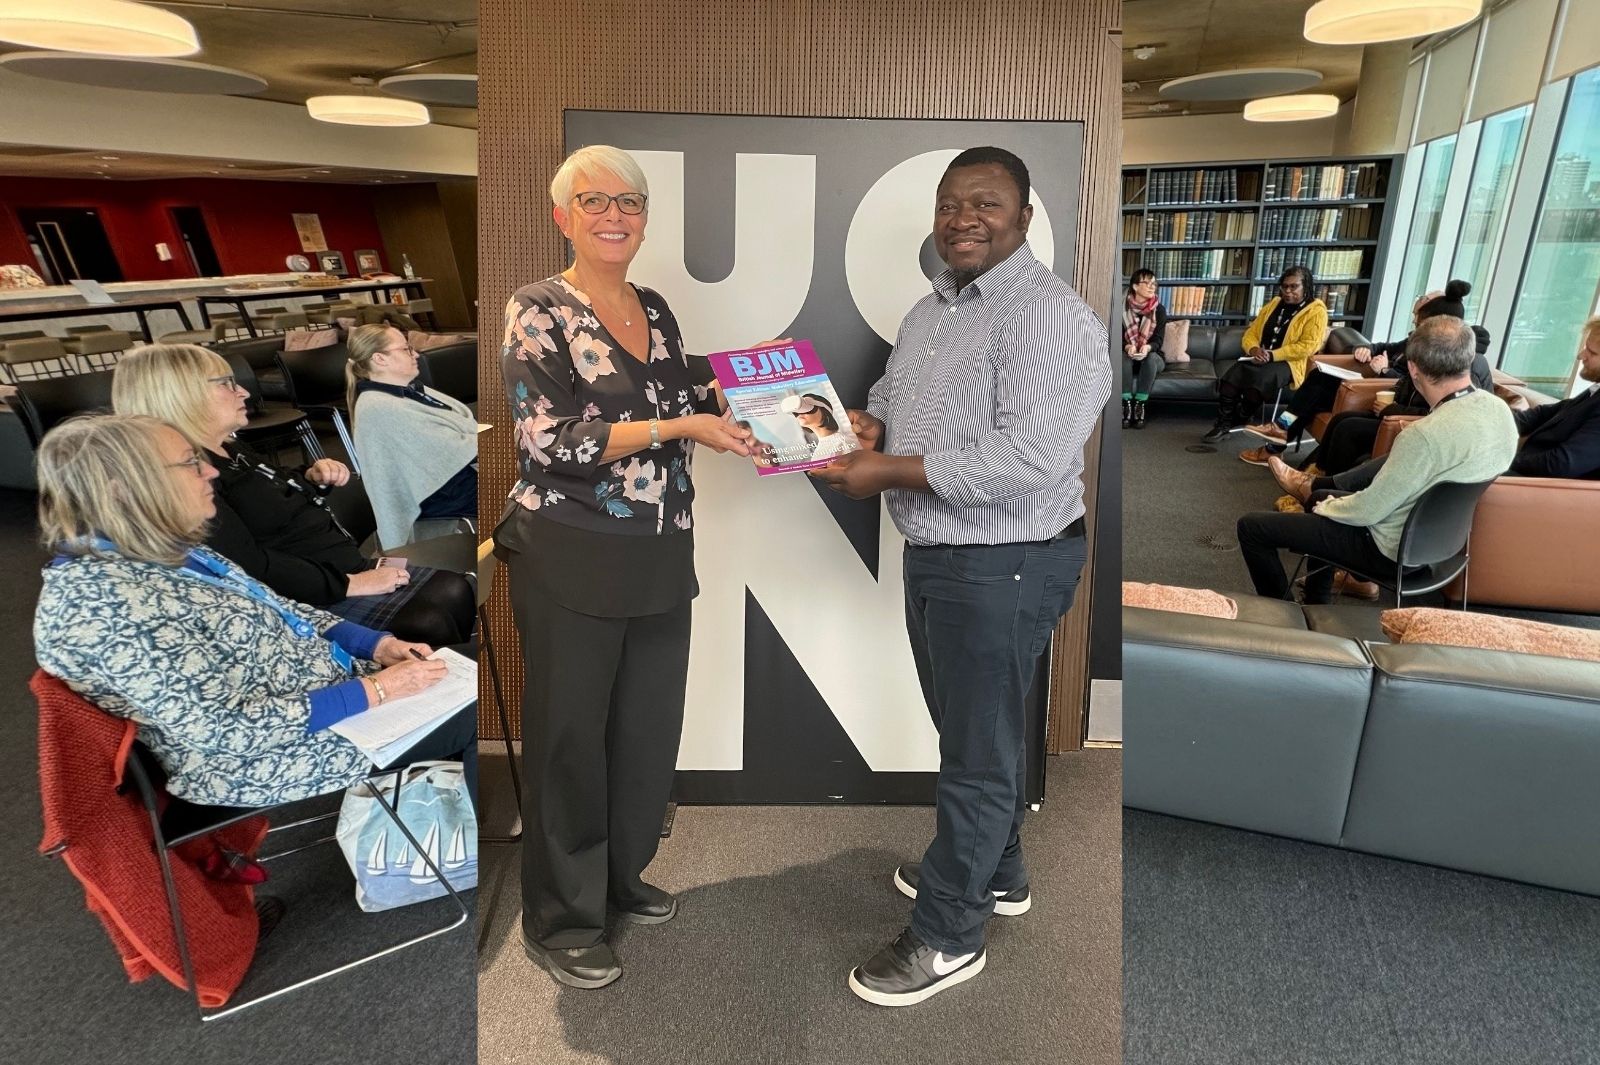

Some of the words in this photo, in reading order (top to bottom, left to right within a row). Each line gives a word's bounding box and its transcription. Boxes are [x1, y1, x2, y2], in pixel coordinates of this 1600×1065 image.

[729, 349, 804, 377] BJM
[781, 369, 806, 377] Midwifery
[762, 446, 789, 455] Using
[789, 440, 818, 453] mixed
[761, 457, 771, 465] to
[772, 453, 809, 464] enhance
